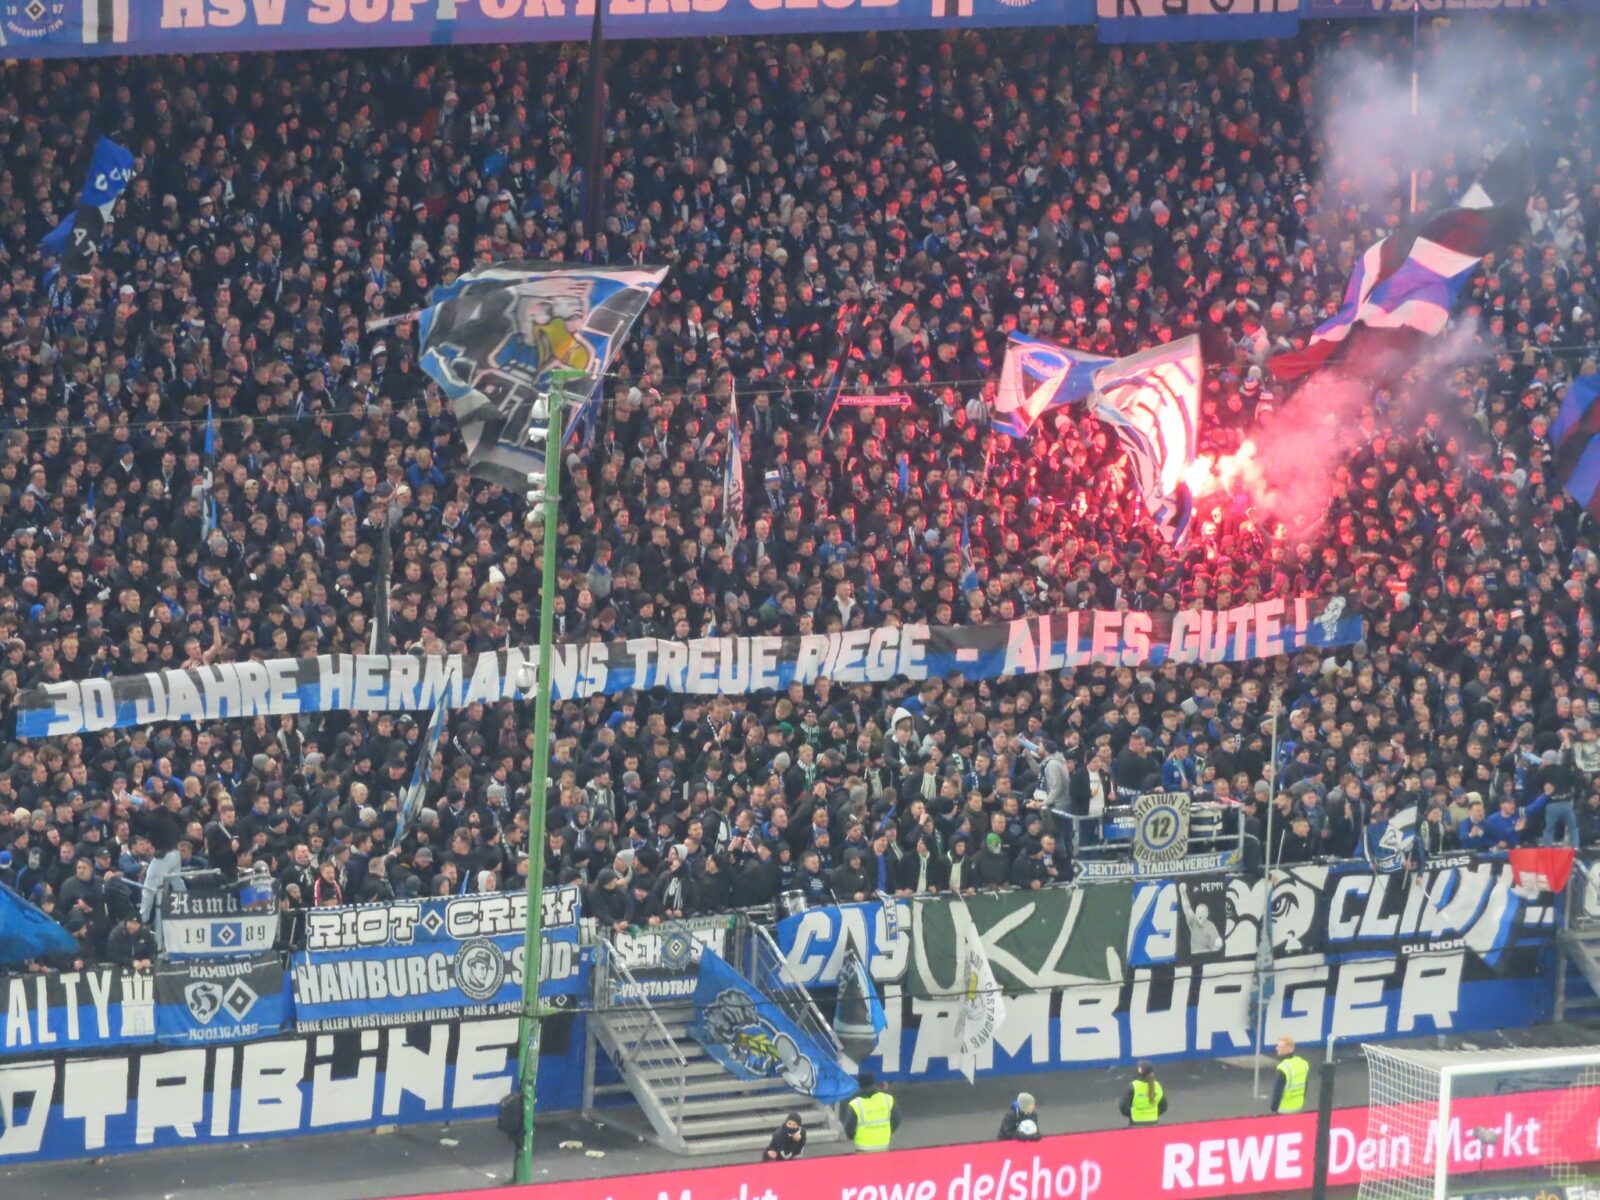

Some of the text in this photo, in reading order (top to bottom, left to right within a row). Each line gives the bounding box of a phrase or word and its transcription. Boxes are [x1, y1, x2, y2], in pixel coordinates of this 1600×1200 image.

[46, 678, 117, 735] 30
[136, 658, 300, 724] JAHRE
[317, 642, 608, 711] HERMANNS
[626, 636, 782, 694] TREUE
[795, 624, 930, 684] RIEGE
[1002, 610, 1152, 676] ALLES
[1169, 598, 1307, 662] GUTE!
[1150, 816, 1172, 839] 12
[1424, 856, 1470, 870] TRAS
[170, 892, 276, 915] Hambg
[308, 905, 419, 948] RIOT
[448, 888, 579, 938] CREW
[184, 928, 205, 944] 19
[1401, 939, 1467, 953] DU NOR
[189, 963, 253, 978] HAMBURG
[298, 953, 449, 1005] HAMBURG
[5, 970, 112, 1046] ALTY
[297, 1019, 321, 1033] EHRE
[322, 1016, 349, 1030] ALLEN
[464, 1003, 487, 1016] FANS
[498, 996, 551, 1013] HOOLNS
[188, 1024, 258, 1040] HOOLIGANS
[1162, 1132, 1304, 1191] REWE
[1328, 1124, 1409, 1174] Dein
